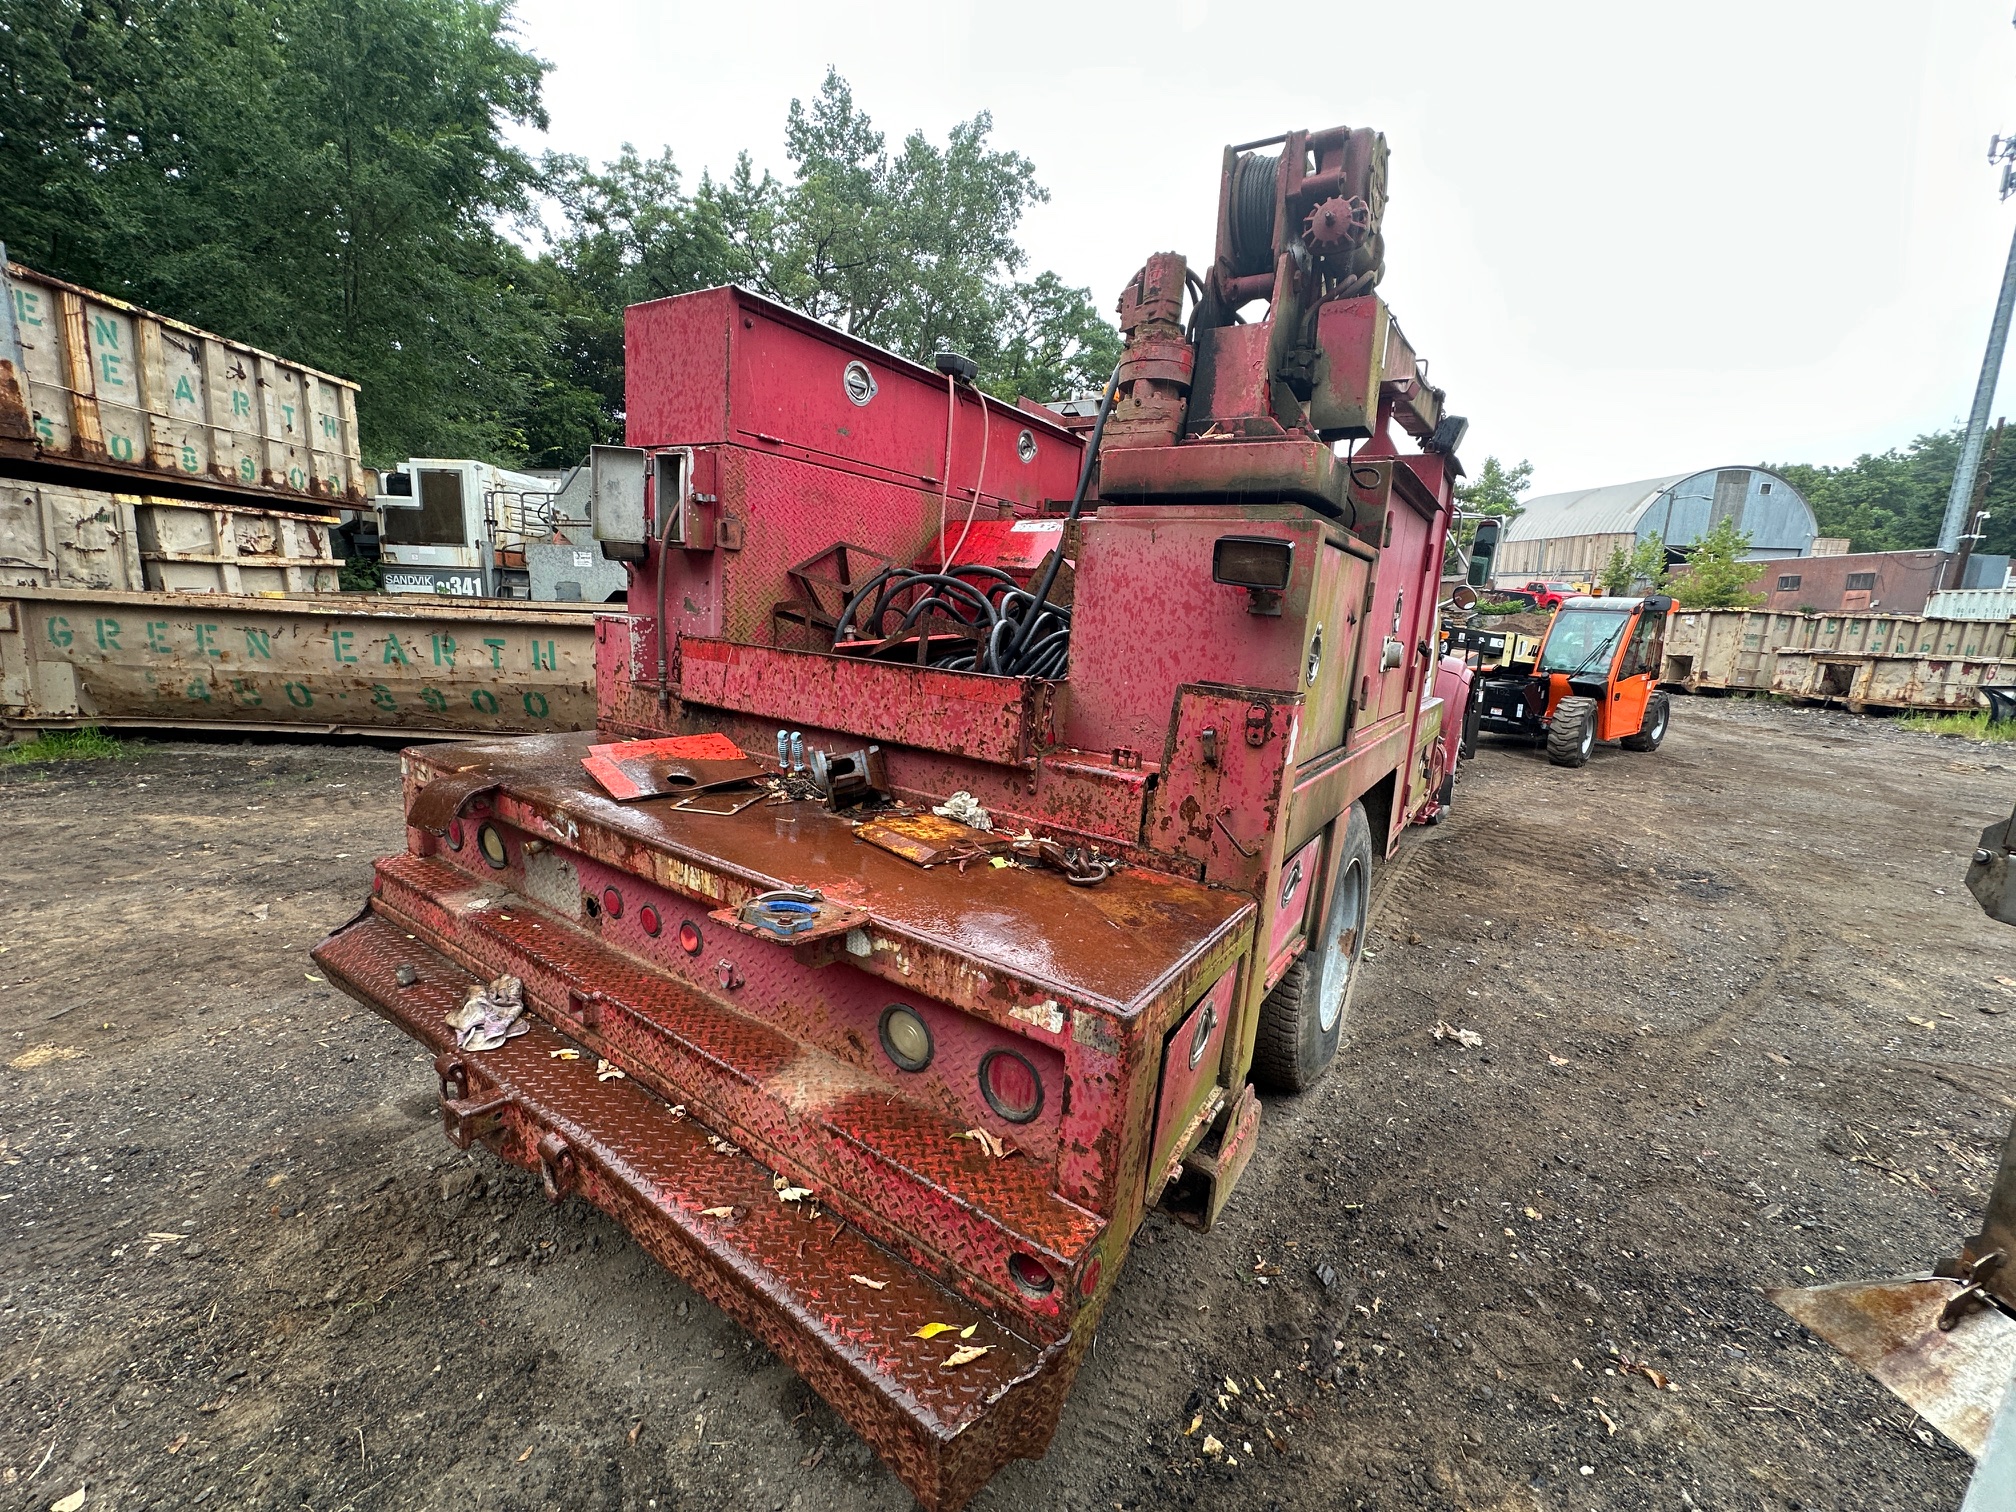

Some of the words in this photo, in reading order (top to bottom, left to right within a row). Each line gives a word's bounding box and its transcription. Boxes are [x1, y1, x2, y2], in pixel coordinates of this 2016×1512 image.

[100, 353, 336, 439] EARTH
[385, 574, 433, 586] SANDVIK
[47, 615, 272, 660] GREEN
[332, 631, 557, 671] EARTH
[1527, 644, 1542, 658] JL
